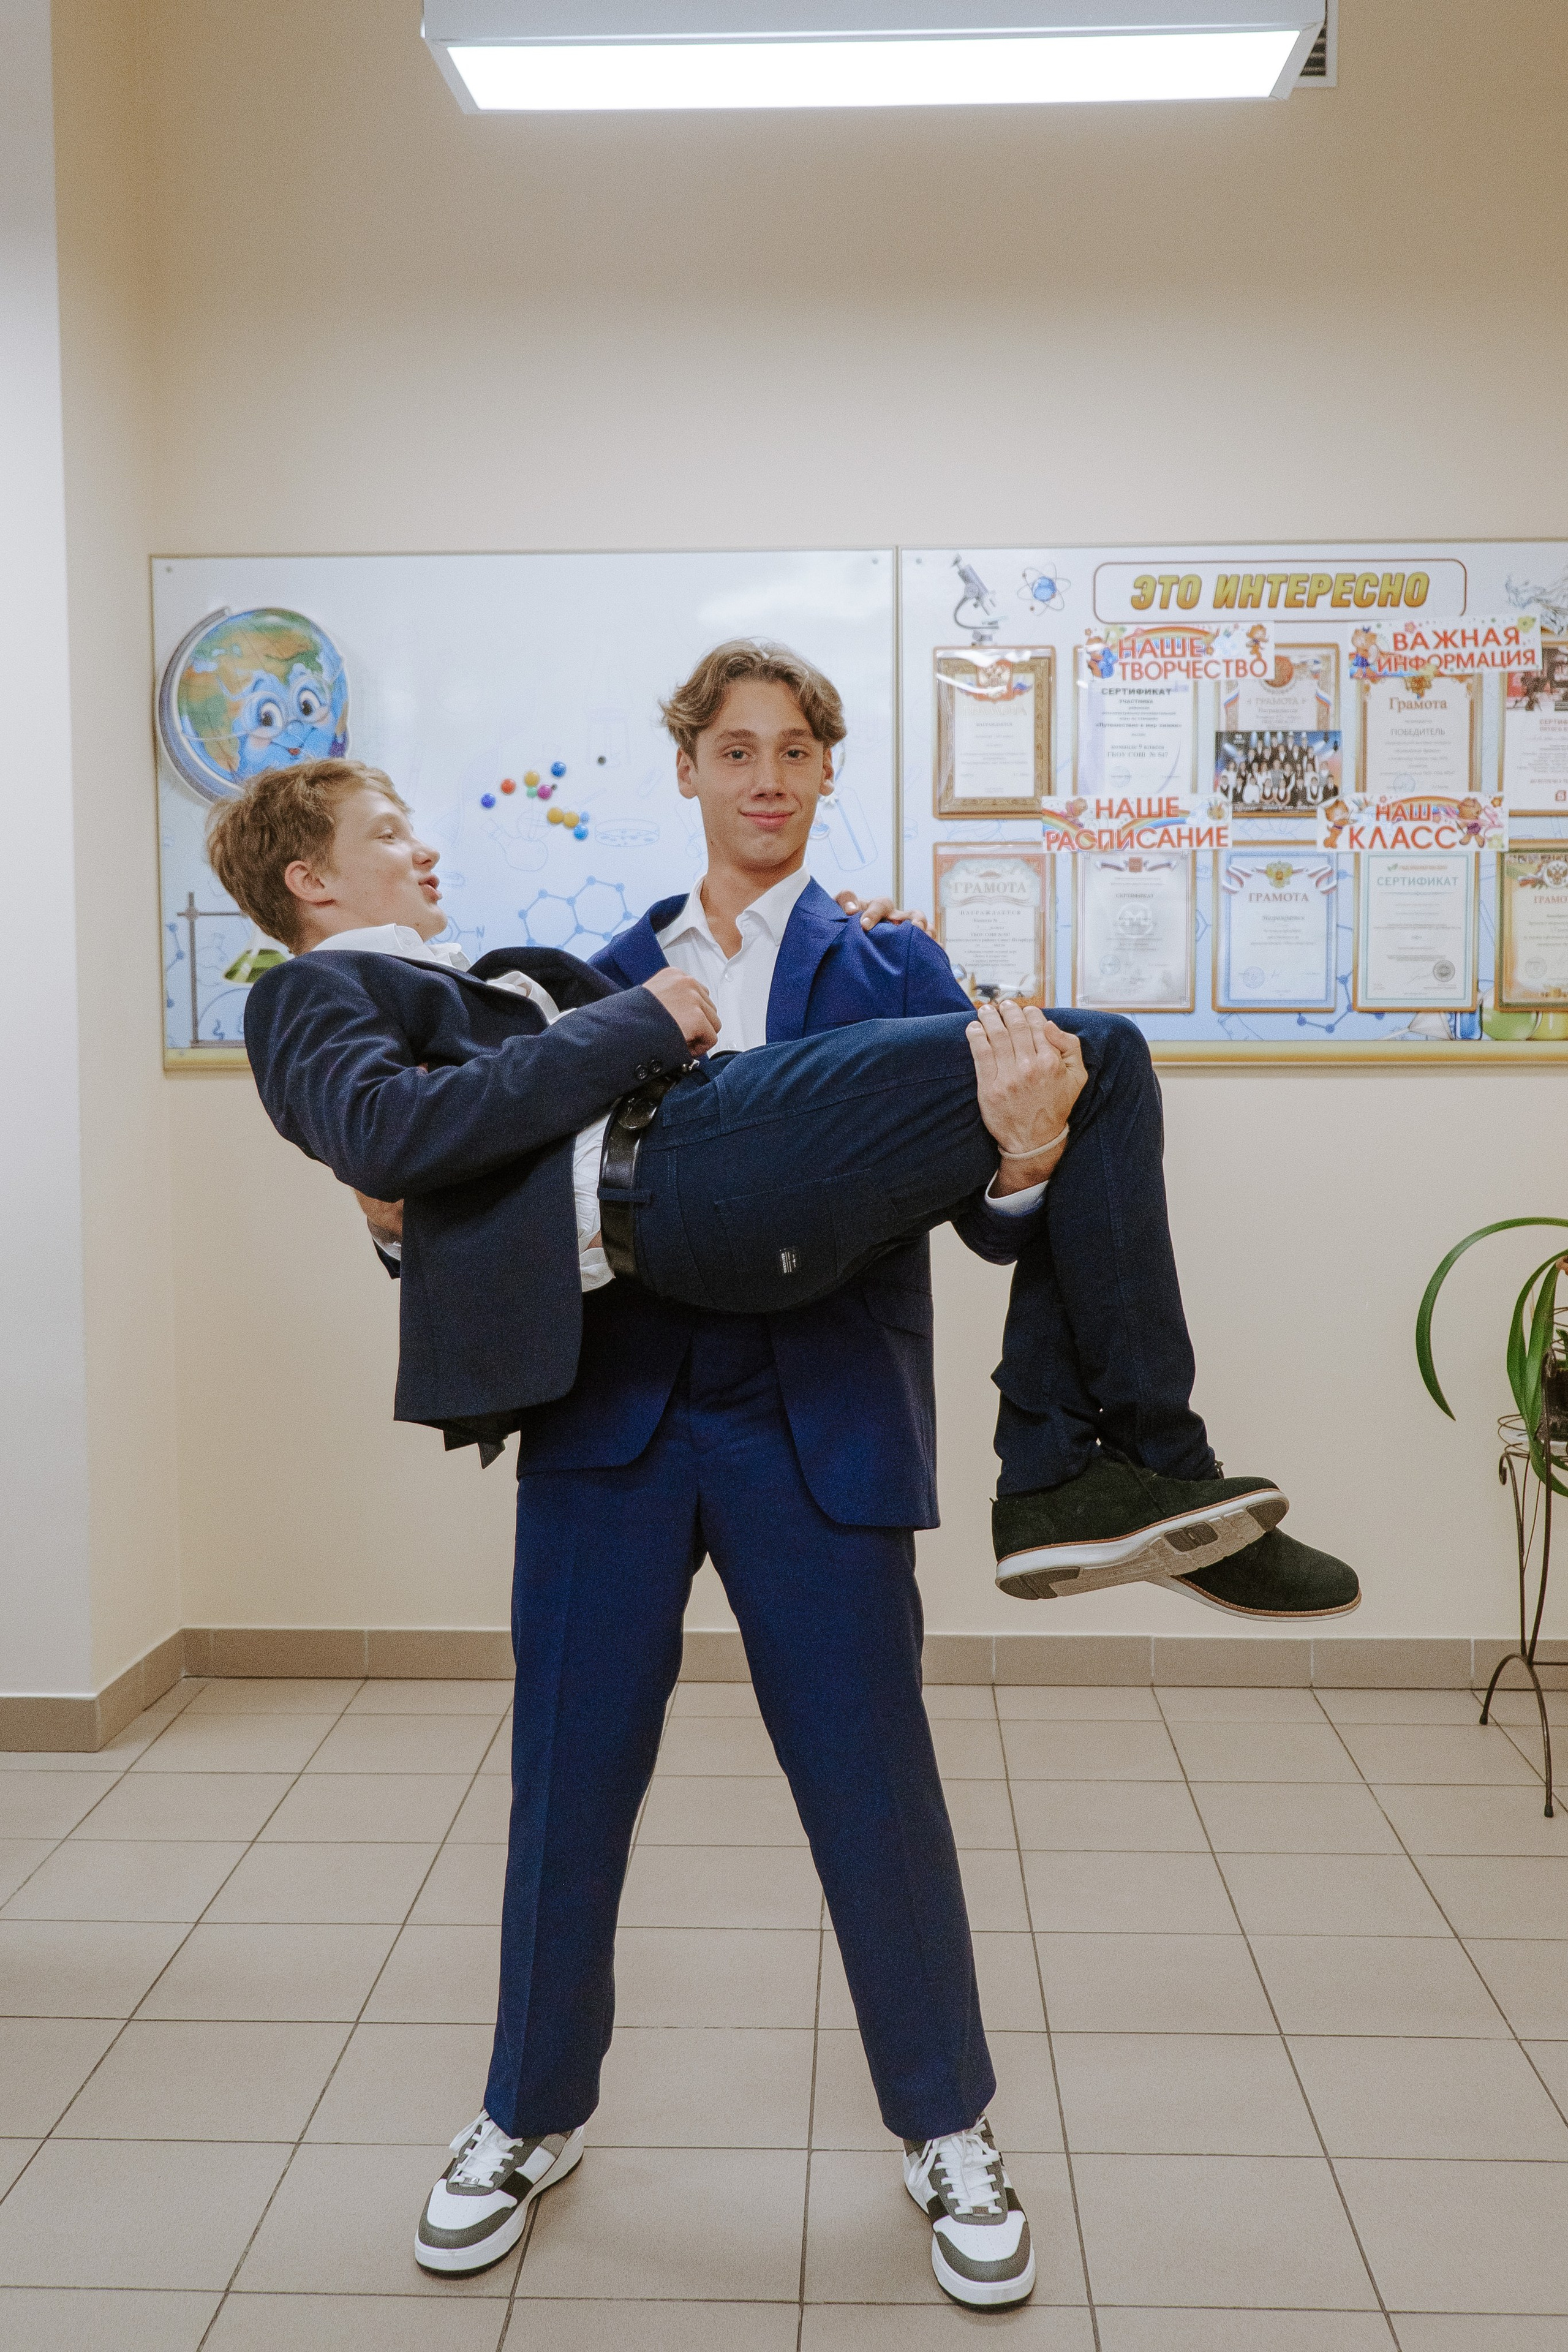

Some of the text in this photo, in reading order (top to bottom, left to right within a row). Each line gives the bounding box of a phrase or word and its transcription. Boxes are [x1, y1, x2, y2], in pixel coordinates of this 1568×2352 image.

[1131, 571, 1430, 610] ЭТО ИНТЕРЕСНО
[1118, 636, 1204, 659] НАШЕ
[1392, 625, 1520, 652] ВАЖНАЯ
[1118, 658, 1268, 681] ТВОРЧЕСТВО
[1377, 648, 1536, 673] ИНФОРМАЦИЯ
[1389, 696, 1448, 713] Грамота
[1390, 728, 1446, 737] ПОБЕДИТЕЛЬ
[1095, 797, 1180, 819] НАШЕ
[1376, 803, 1431, 821] НАШ
[1045, 826, 1229, 852] РАСПИСАНИЕ
[1349, 826, 1457, 850] КЛАСС
[954, 881, 1027, 894] ГРАМОТА
[1378, 876, 1459, 886] СЕРТИФИКАТ
[1248, 892, 1310, 902] ГРАМОТА
